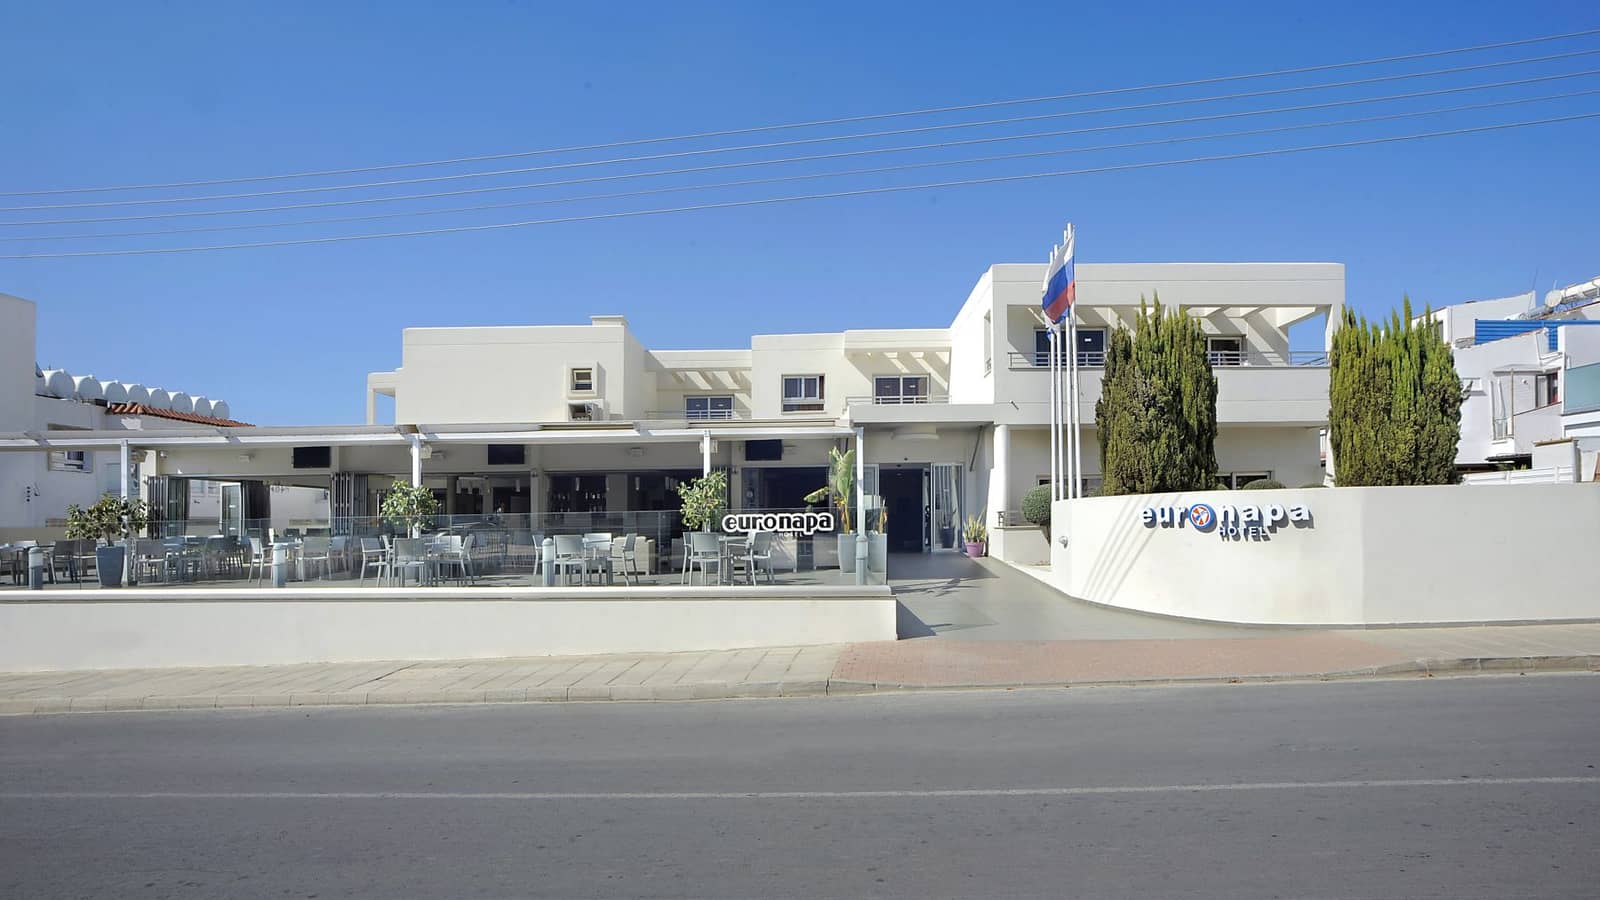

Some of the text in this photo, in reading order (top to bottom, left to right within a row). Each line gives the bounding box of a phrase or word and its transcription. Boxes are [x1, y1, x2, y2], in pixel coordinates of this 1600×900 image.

[722, 512, 834, 535] euronapa
[1140, 503, 1311, 529] euronapa
[1218, 526, 1267, 536] HOTEL
